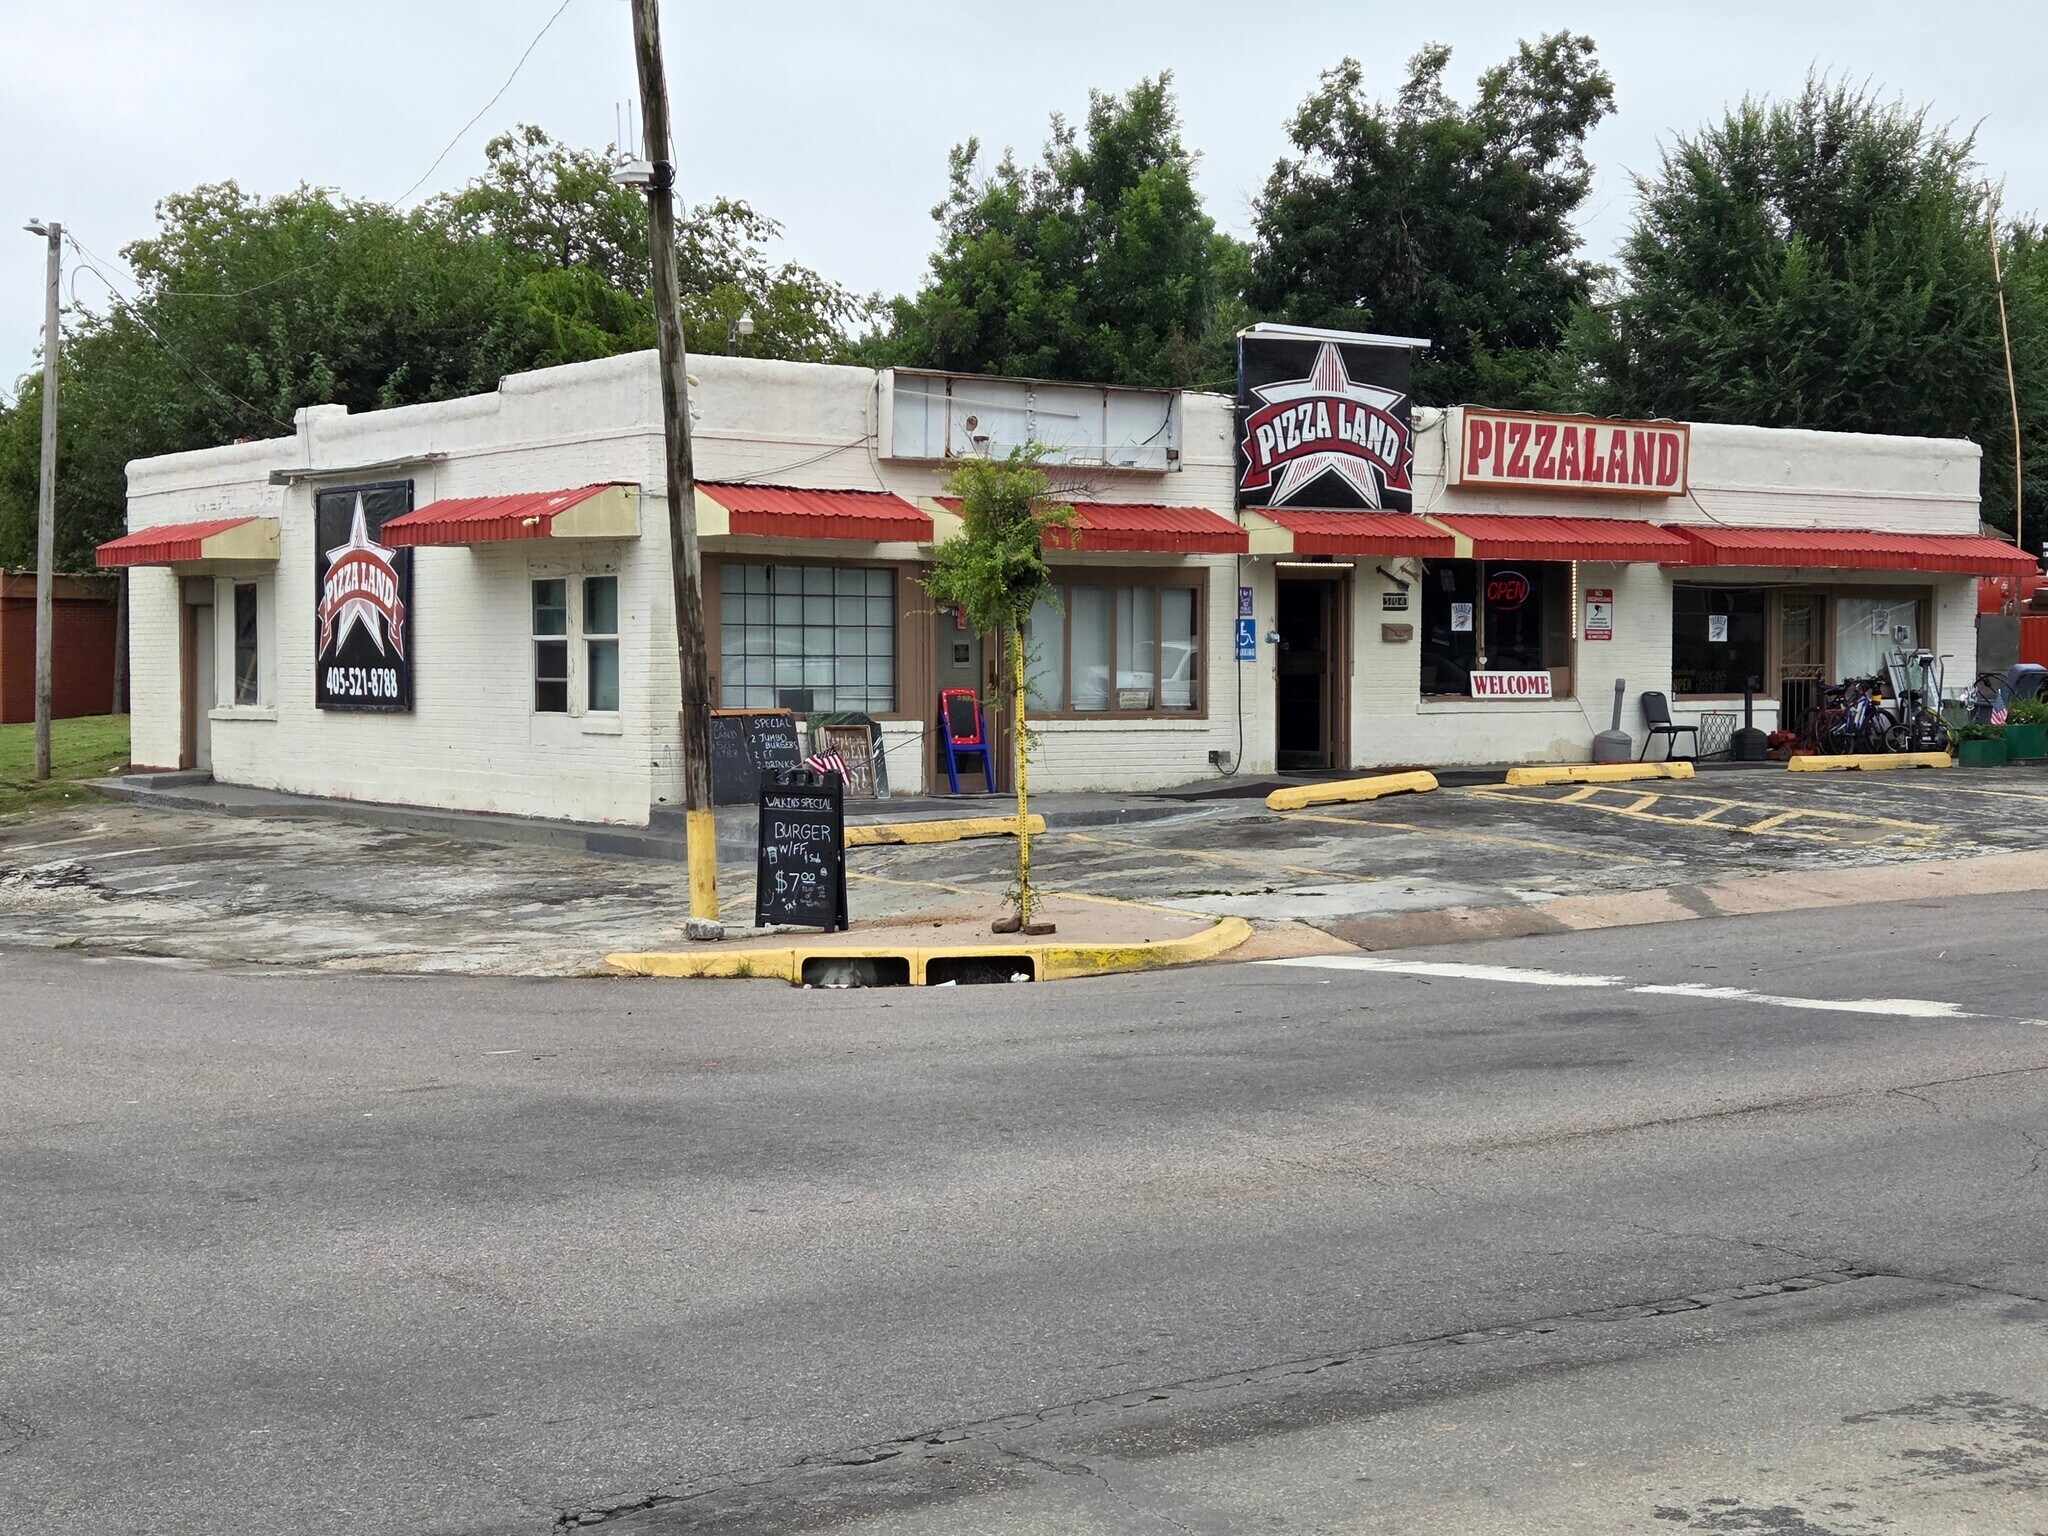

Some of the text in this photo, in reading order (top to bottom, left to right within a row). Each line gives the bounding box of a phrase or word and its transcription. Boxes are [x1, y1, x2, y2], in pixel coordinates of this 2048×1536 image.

[1255, 401, 1400, 467] PIZZA LAND
[1467, 419, 1680, 487] PIZZALAND
[326, 561, 394, 612] PIZZA LAND
[1487, 580, 1526, 601] OPEN
[326, 667, 398, 698] 405-521-8788
[1472, 675, 1550, 696] WELCOME
[754, 717, 792, 729] SPECIAL
[758, 733, 788, 742] JUMBO
[765, 741, 798, 750] BURGERS
[850, 745, 867, 759] EAT
[801, 797, 833, 810] SPECIAL
[774, 821, 831, 842] BURGER
[778, 840, 809, 857] W/FF
